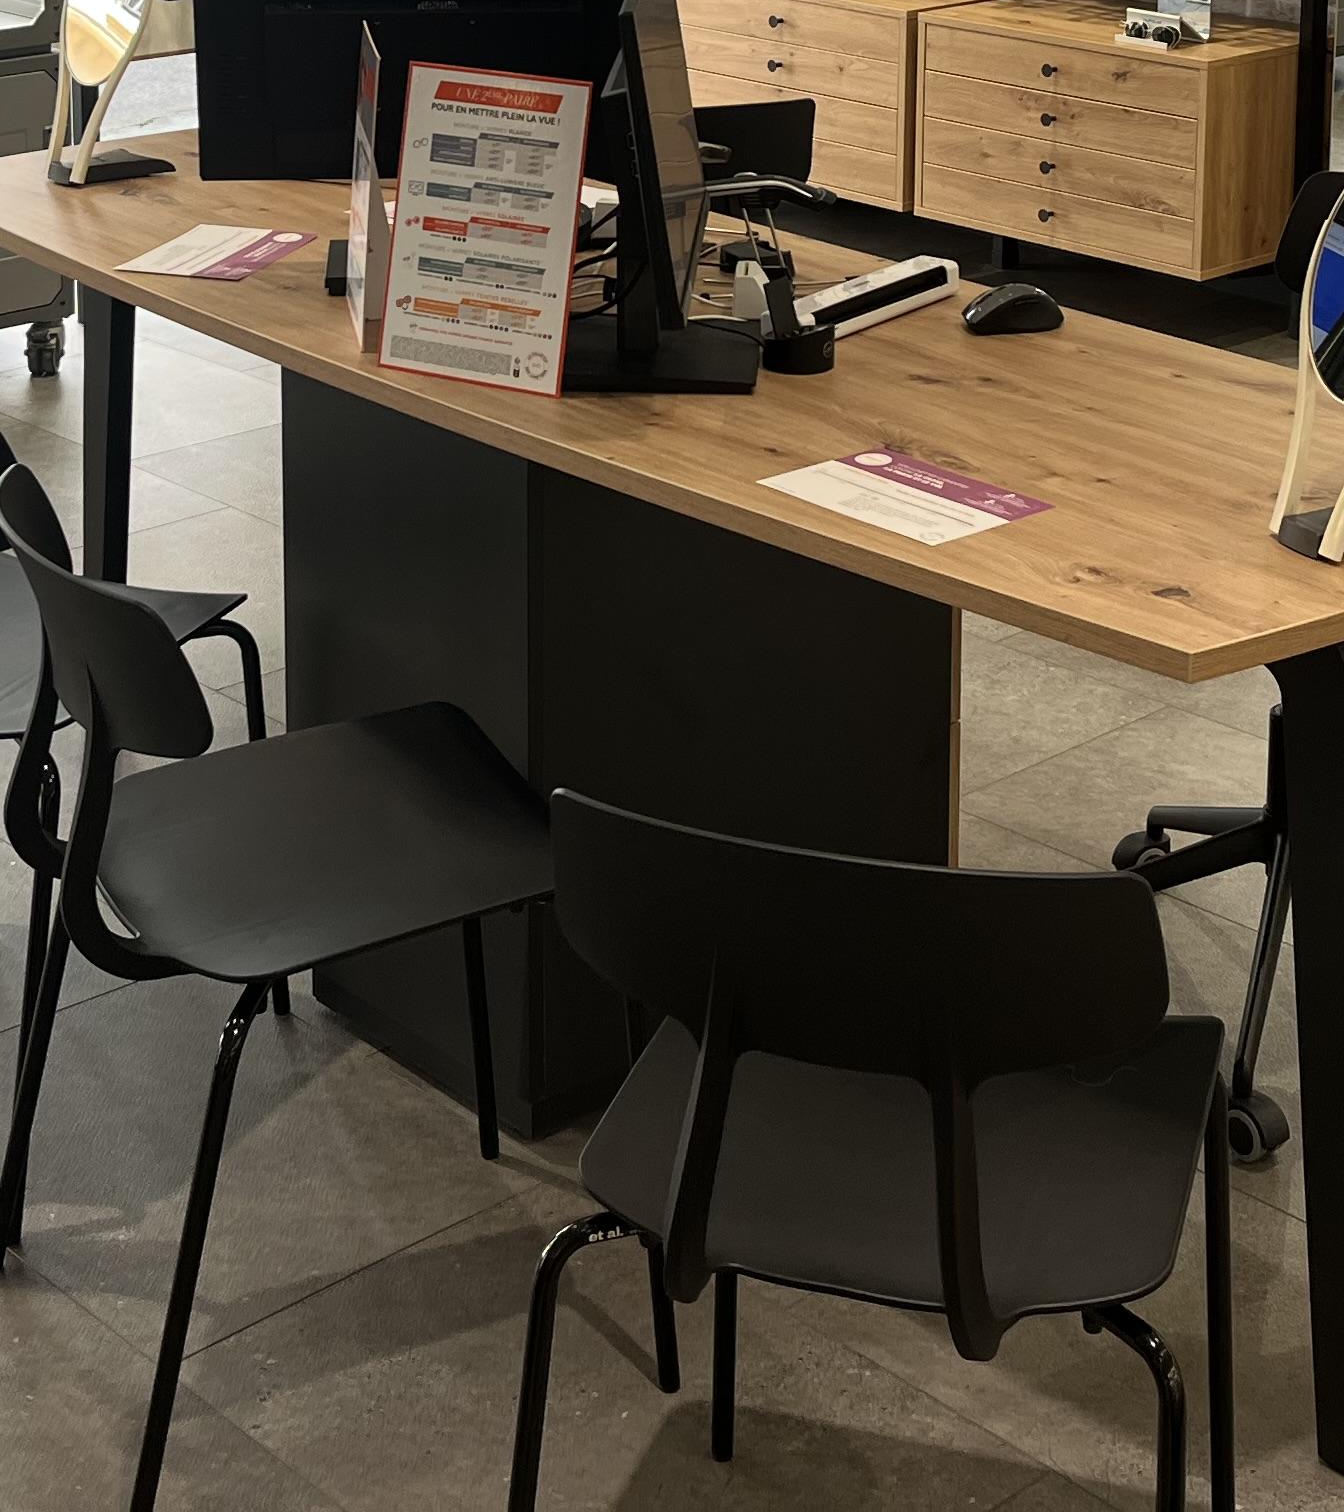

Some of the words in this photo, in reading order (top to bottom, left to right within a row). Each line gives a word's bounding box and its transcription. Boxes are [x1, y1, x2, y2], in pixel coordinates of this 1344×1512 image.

[431, 102, 454, 112] POUR
[456, 105, 467, 114] EN
[468, 107, 499, 119] METTRE
[501, 111, 524, 122] PLEIN
[526, 114, 536, 123] LA
[538, 116, 556, 126] VUE
